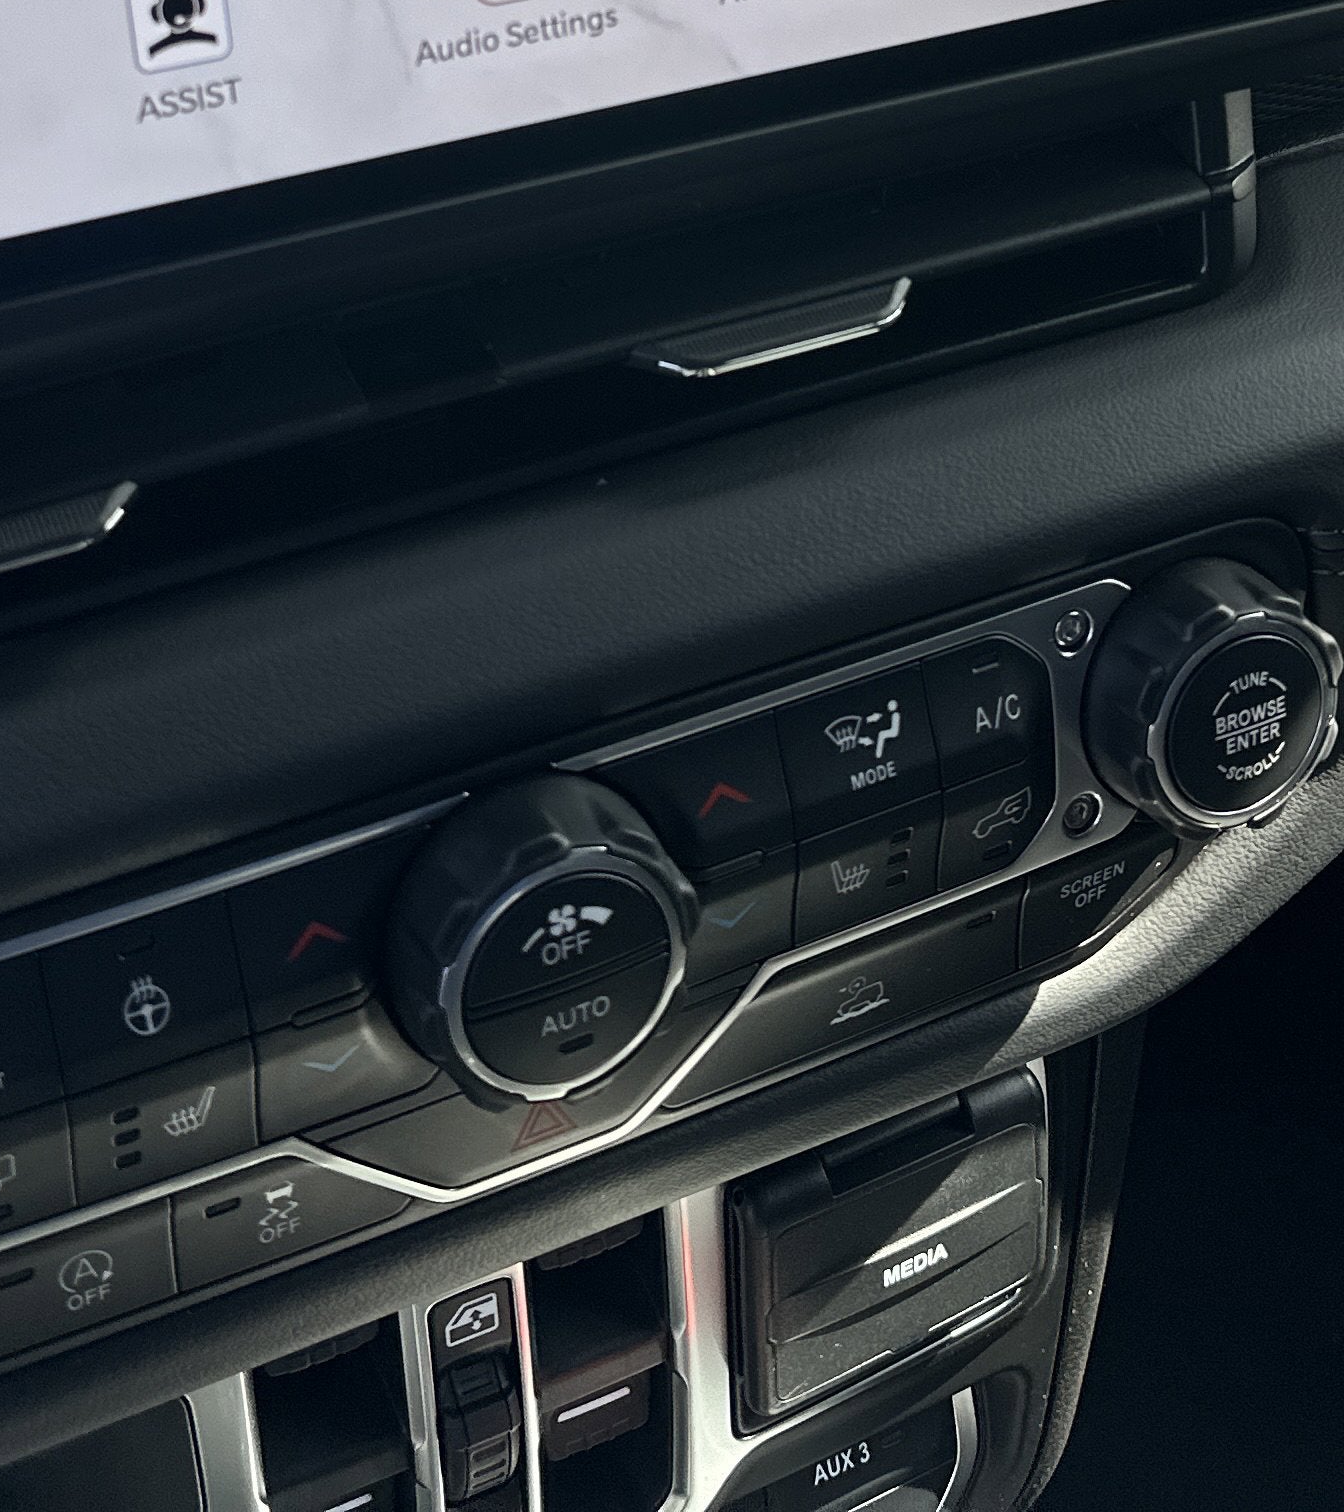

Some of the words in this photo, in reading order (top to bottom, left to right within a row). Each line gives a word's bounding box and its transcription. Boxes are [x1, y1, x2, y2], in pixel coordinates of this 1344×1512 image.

[414, 29, 500, 67] Audio
[505, 4, 618, 53] Settings
[136, 77, 242, 123] ASSIST
[1230, 671, 1269, 695] TUNE
[975, 694, 1021, 733] A/C
[1214, 695, 1287, 735] BROWSE
[1226, 723, 1280, 755] ENTER
[851, 761, 897, 790] MODE
[1225, 752, 1280, 781] SCROLL
[1060, 861, 1126, 899] SCREEN
[1074, 884, 1108, 908] OFF
[541, 930, 591, 966] OFF
[540, 995, 611, 1038] AUTO
[259, 1217, 302, 1243] OFF
[883, 1242, 948, 1287] MEDIA
[67, 1284, 111, 1311] OFF
[814, 1448, 855, 1485] AUX
[859, 1441, 871, 1465] 3
